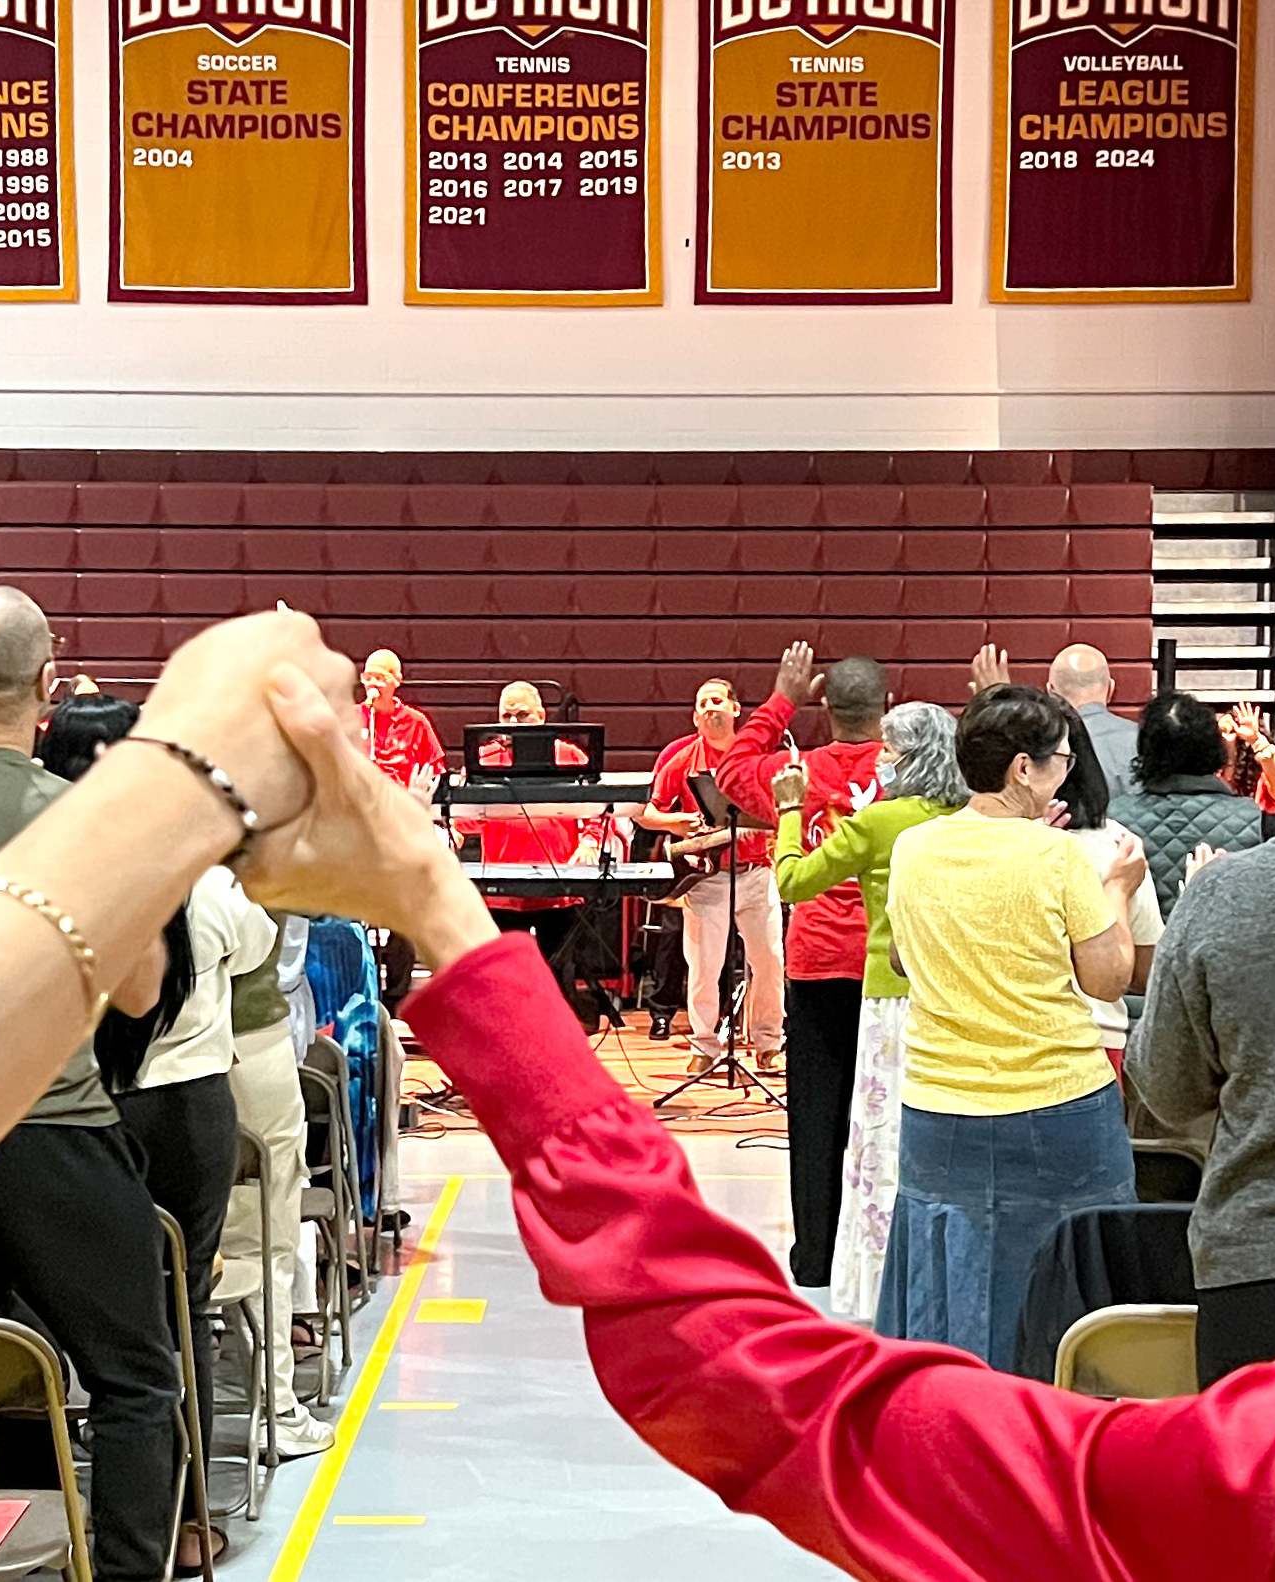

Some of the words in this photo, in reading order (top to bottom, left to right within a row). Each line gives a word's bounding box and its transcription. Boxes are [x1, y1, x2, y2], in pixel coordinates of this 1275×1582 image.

[197, 54, 277, 72] SOCCER
[495, 56, 571, 74] TENNIS
[789, 56, 865, 73] TENNIS
[1063, 54, 1184, 72] VOLLEYBALL
[187, 79, 288, 106] STATE
[427, 81, 640, 108] CONFERENCE
[776, 81, 878, 108] STATE
[1059, 79, 1189, 107] LEAGUE
[131, 111, 342, 140] CHAMPIONS
[427, 113, 640, 142] CHAMPIONS
[721, 112, 931, 141] CHAMPIONS
[1019, 112, 1227, 141] CHAMPIONS
[133, 147, 193, 168] 2004
[428, 151, 488, 171] 2013
[503, 152, 563, 171] 2014
[579, 149, 638, 169] 2015
[722, 151, 781, 170] 2013
[1019, 150, 1078, 170] 2018
[1095, 149, 1155, 168] 2024
[428, 178, 488, 199] 2016
[503, 178, 563, 198] 2017
[579, 176, 638, 197] 2019
[428, 205, 486, 226] 2021
